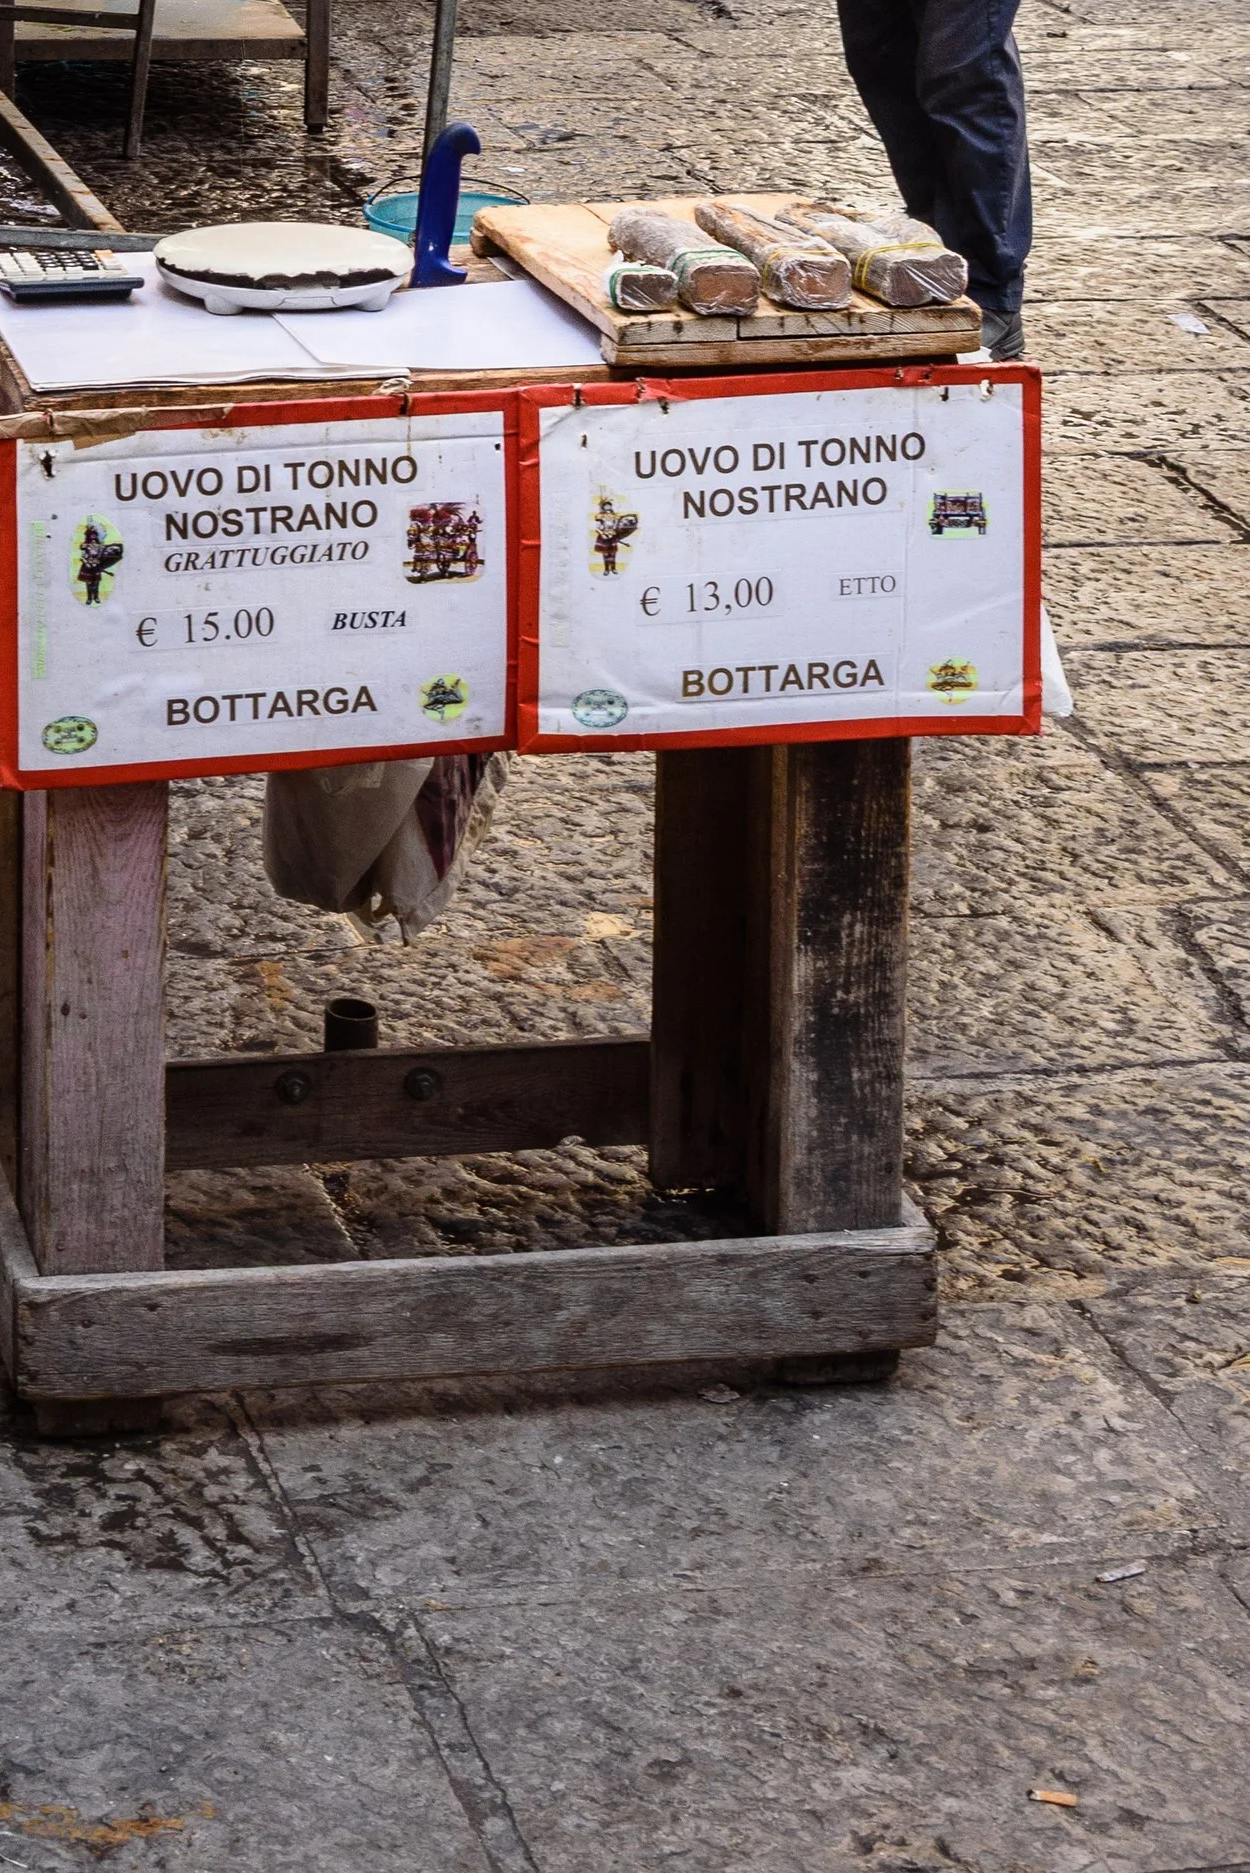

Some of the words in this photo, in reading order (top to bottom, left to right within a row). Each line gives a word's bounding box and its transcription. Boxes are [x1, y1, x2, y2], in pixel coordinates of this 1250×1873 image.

[635, 445, 739, 479] UOVO
[753, 441, 785, 472] DI
[797, 431, 926, 469] TONNO
[114, 467, 223, 502] UOVO
[237, 464, 271, 494] DI
[283, 454, 418, 491] TONNO
[683, 476, 888, 520] NOSTRANO
[165, 499, 379, 541] NOSTRANO
[164, 540, 369, 573] GRATTUGGIATO
[639, 585, 661, 616] €
[686, 575, 774, 617] 13,00
[838, 574, 897, 596] ETTO
[136, 617, 159, 648] €
[183, 606, 275, 644] 15.00
[331, 610, 407, 631] BUSTA
[681, 658, 886, 699] BOTTARGA
[166, 684, 379, 727] BOTTARGA
